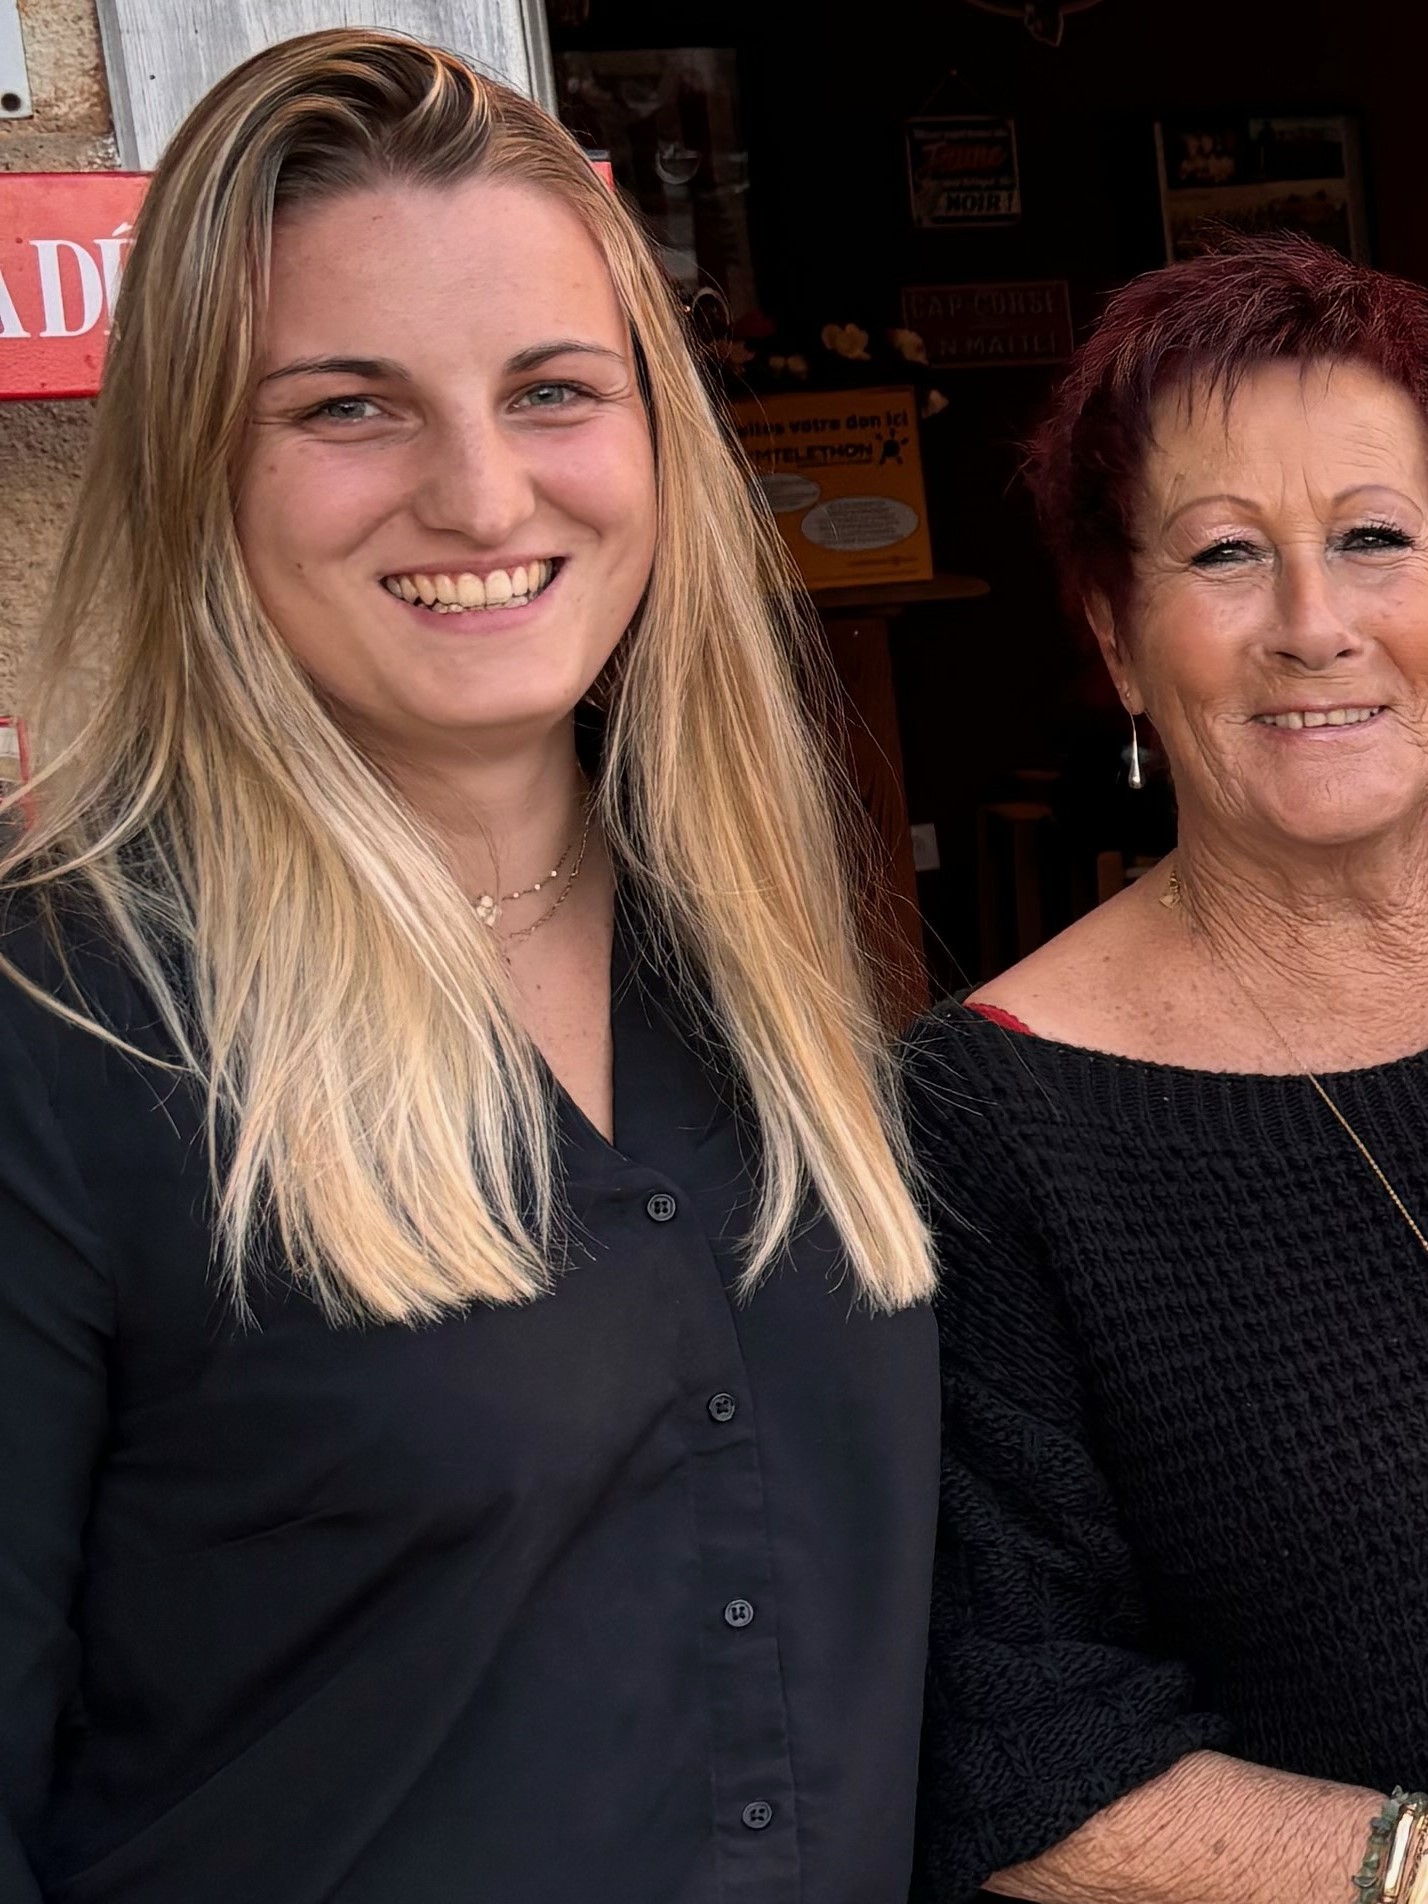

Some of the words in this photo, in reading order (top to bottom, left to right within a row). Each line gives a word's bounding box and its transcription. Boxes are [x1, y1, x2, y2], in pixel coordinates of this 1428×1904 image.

[789, 417, 841, 434] votre
[845, 413, 882, 429] don
[886, 409, 909, 427] ici
